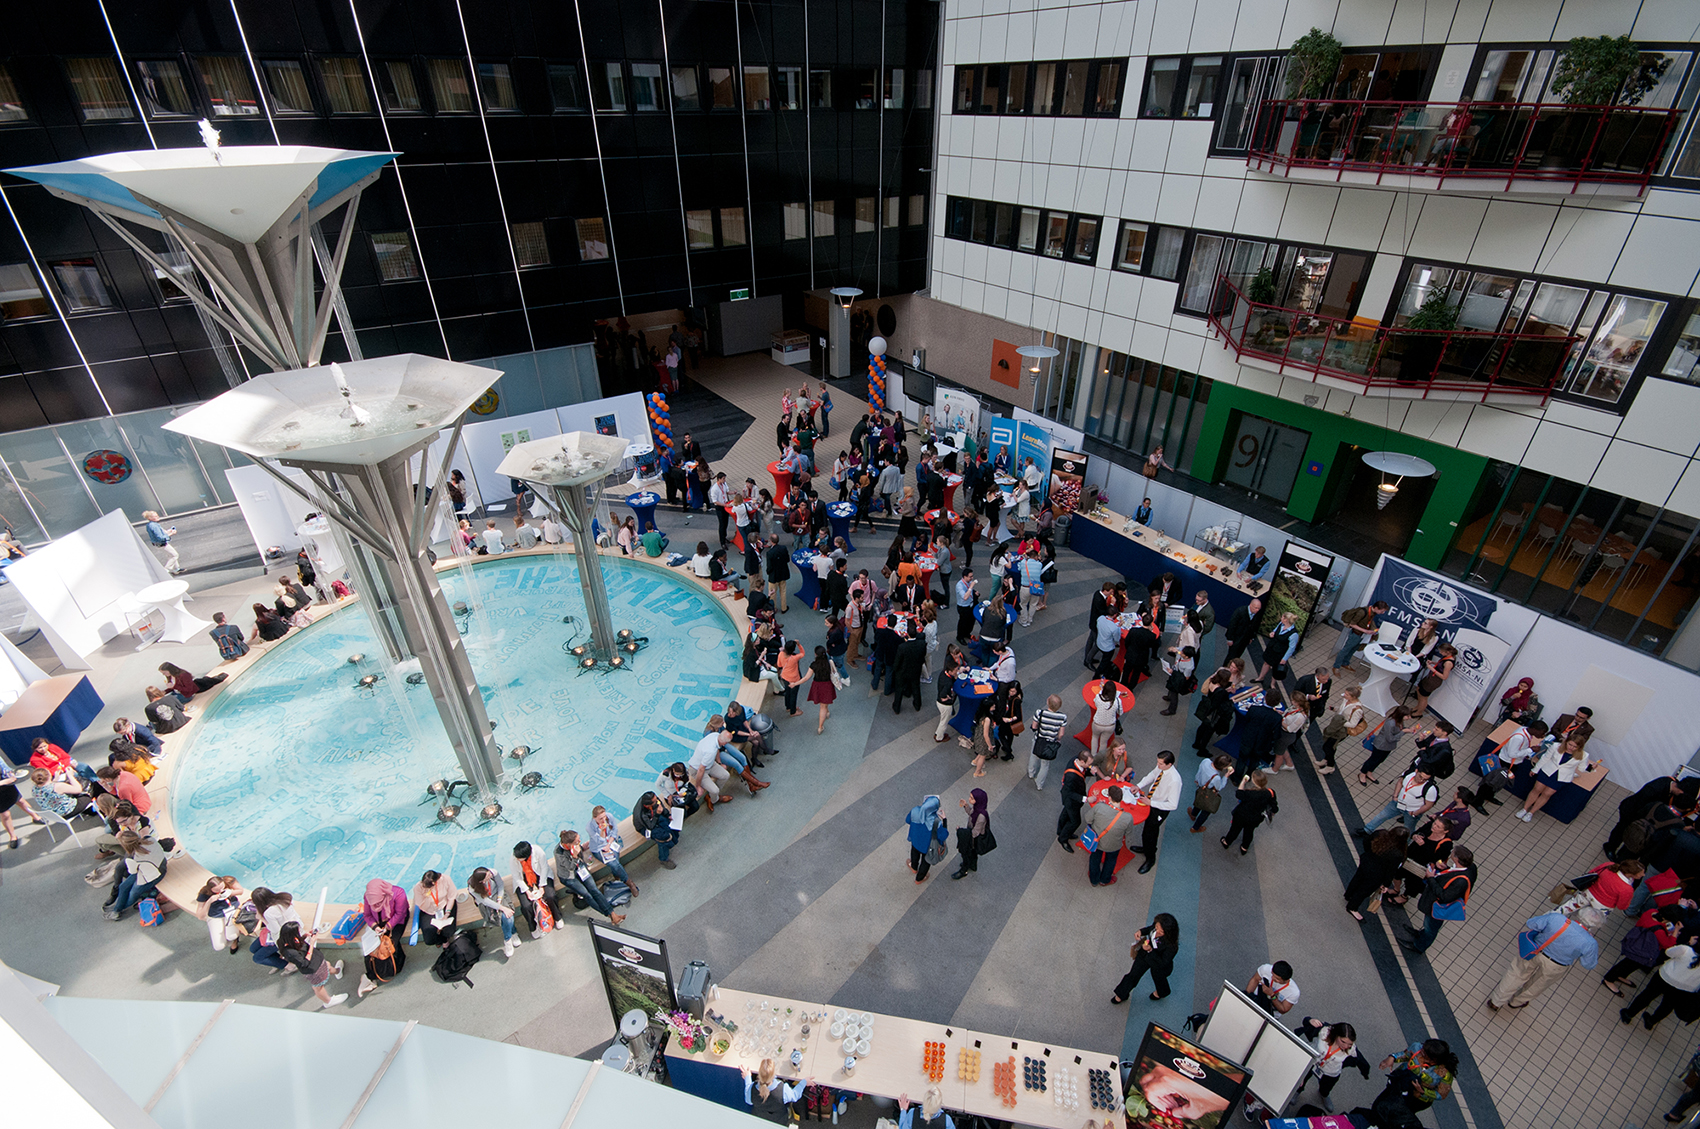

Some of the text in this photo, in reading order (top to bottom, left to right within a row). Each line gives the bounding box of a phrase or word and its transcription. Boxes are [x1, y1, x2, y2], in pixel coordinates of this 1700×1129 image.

[1234, 433, 1260, 468] 9
[644, 587, 713, 626] ICH
[1387, 605, 1456, 643] FMS-N
[1455, 660, 1484, 686] MSA-NL
[550, 688, 582, 731] LOVE
[572, 686, 669, 793] GET WELL SOON
[588, 791, 634, 821] I
